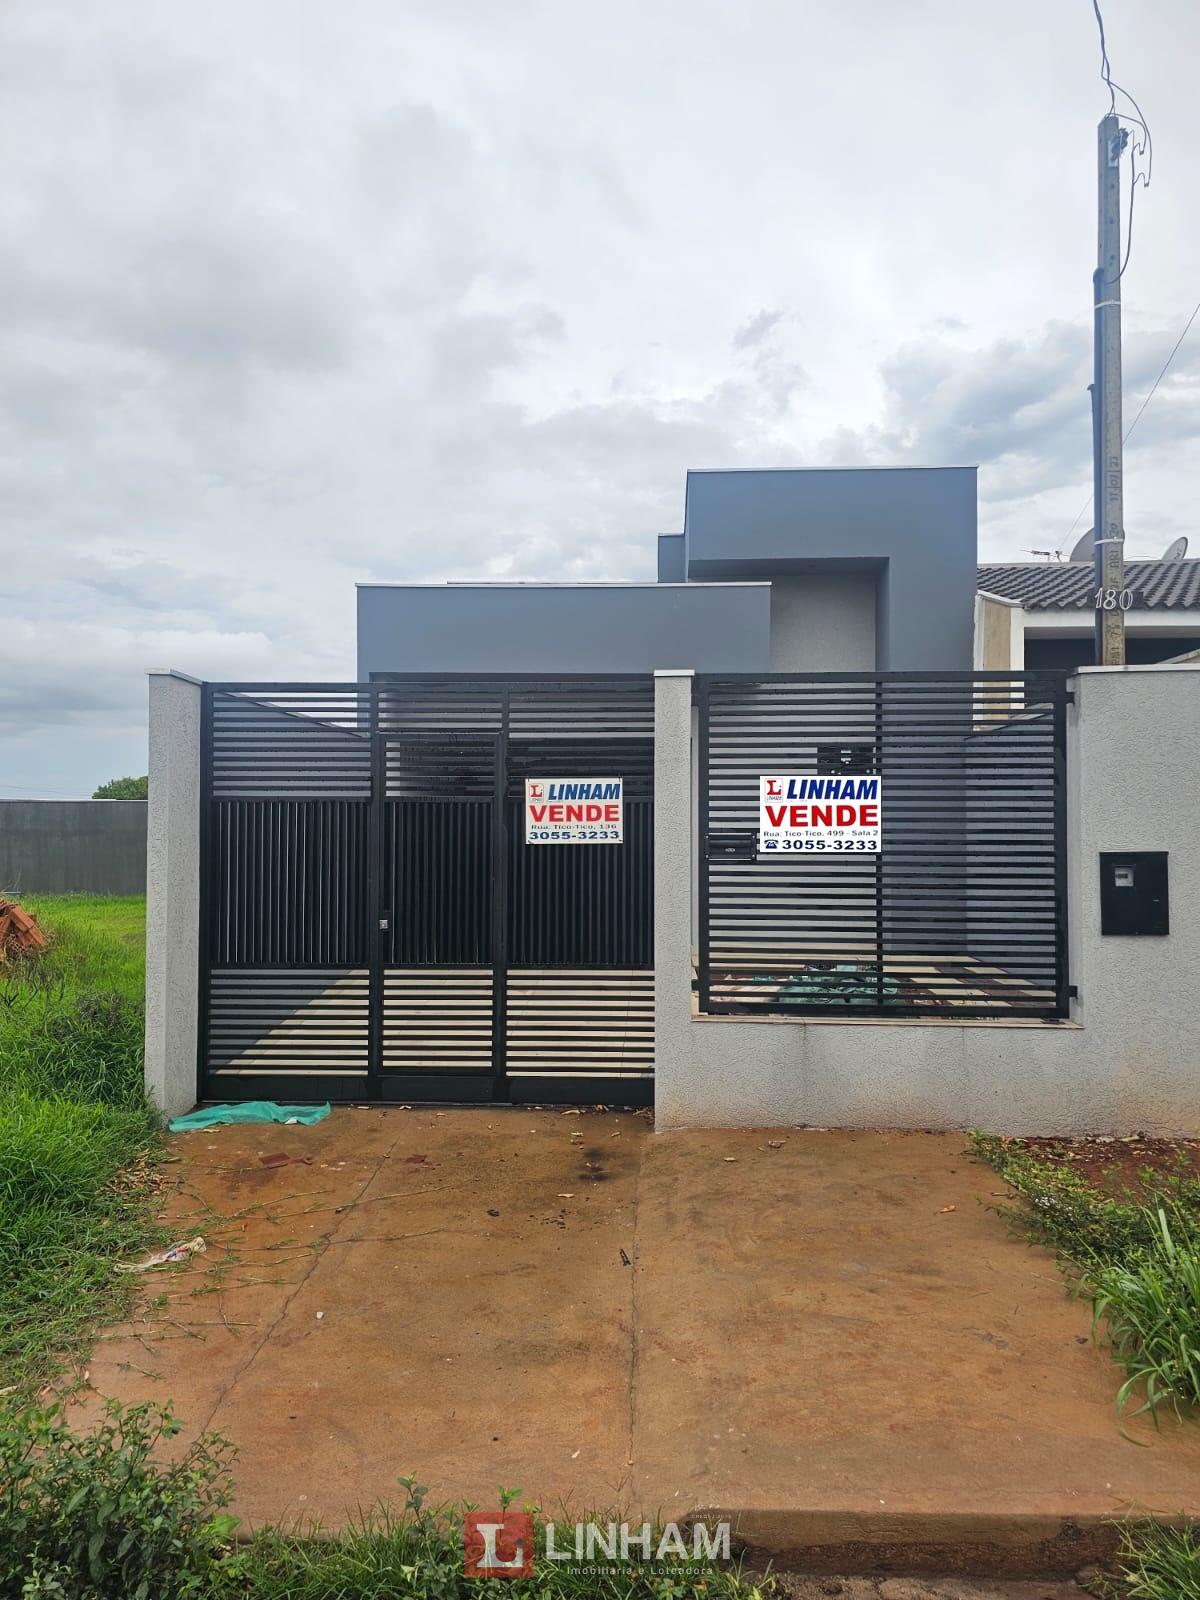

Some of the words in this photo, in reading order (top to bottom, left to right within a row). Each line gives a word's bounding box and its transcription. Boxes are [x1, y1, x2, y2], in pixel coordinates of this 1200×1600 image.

[1094, 588, 1133, 610] 180
[548, 783, 621, 800] LINHAM
[786, 779, 878, 800] LINHAM
[529, 804, 619, 822] VENDE
[765, 804, 879, 827] VENDE
[529, 831, 620, 840] 3055-3233
[782, 839, 878, 850] 3055-3233
